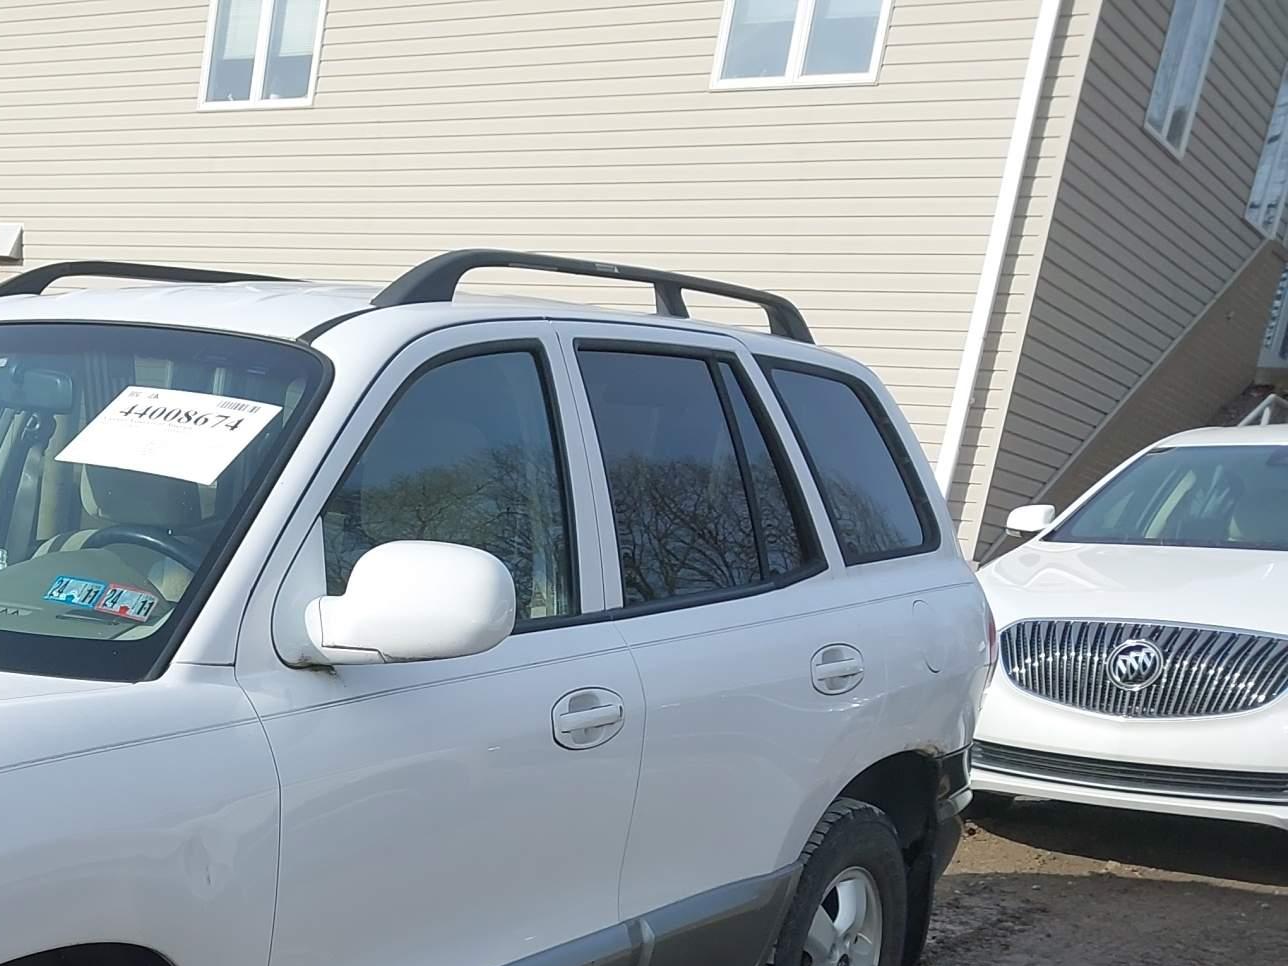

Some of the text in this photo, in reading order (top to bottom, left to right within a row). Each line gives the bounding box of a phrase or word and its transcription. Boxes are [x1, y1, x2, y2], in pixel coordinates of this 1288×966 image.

[119, 403, 245, 431] 44008674
[48, 579, 70, 597] 24
[104, 588, 123, 608] 24
